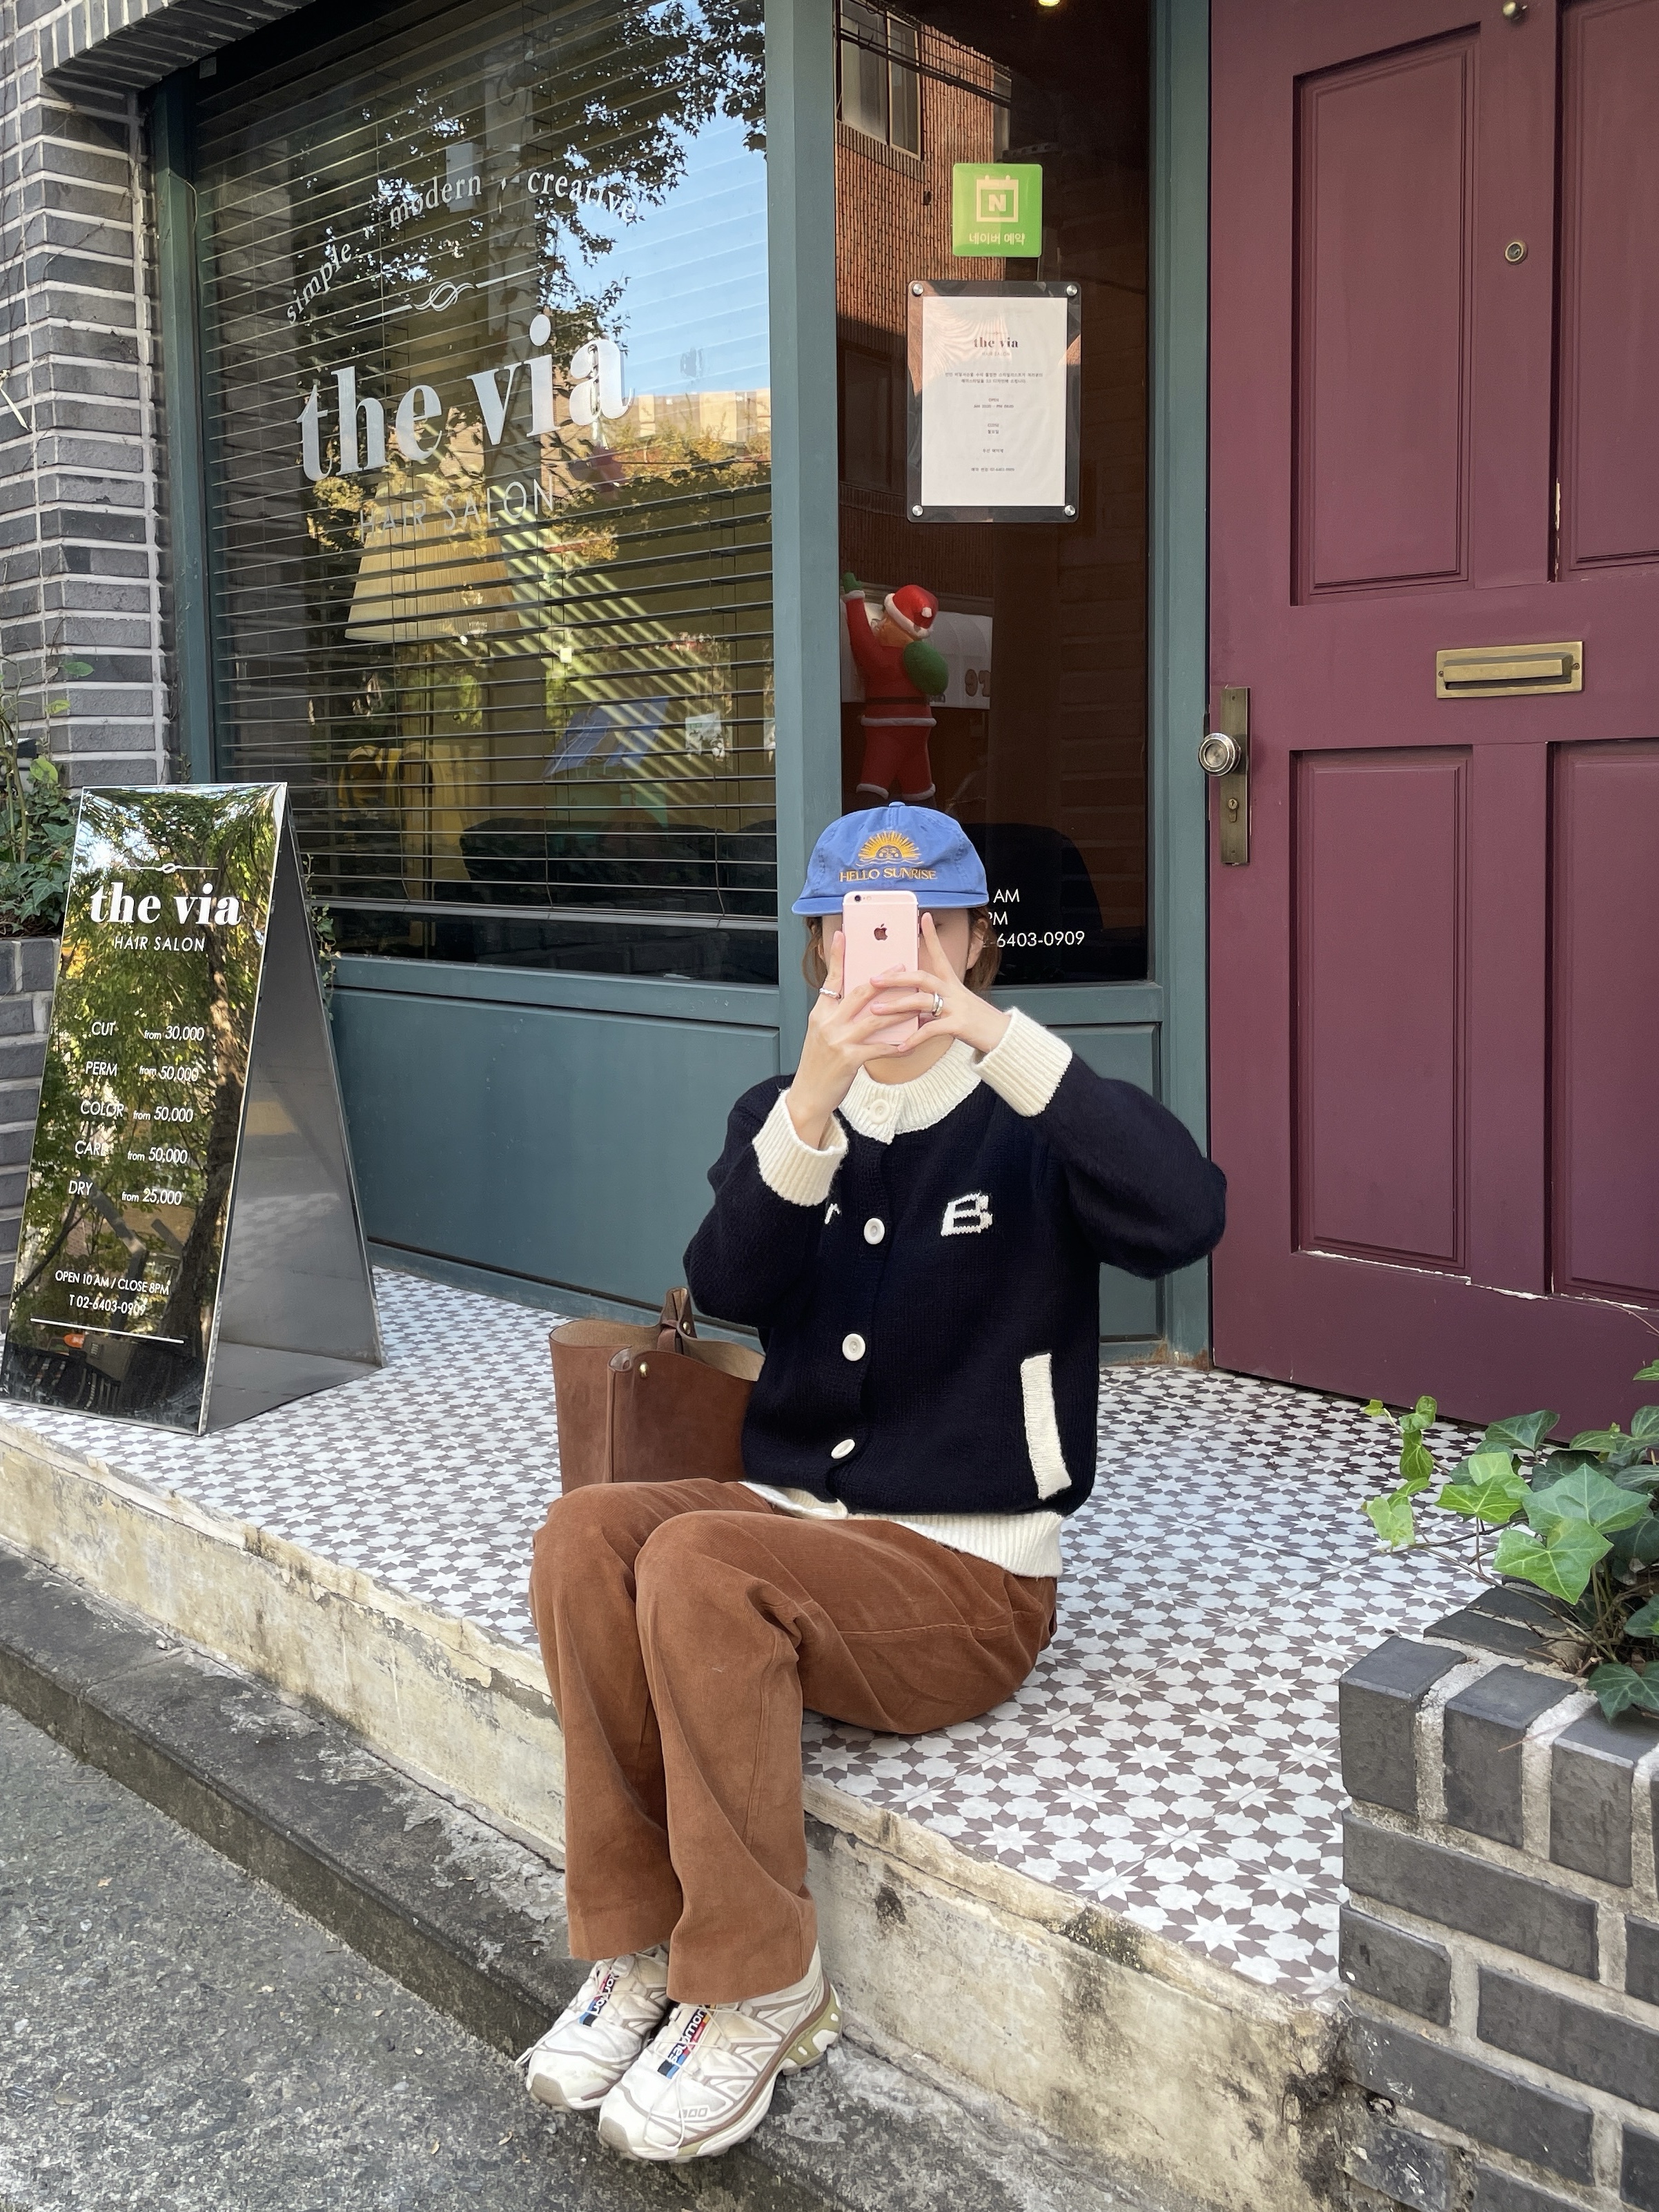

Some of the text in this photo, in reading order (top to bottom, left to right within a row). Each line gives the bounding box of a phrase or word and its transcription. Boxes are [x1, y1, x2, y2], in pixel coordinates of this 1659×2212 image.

[988, 194, 1006, 212] N
[286, 172, 636, 325] simple modern creative
[969, 232, 1025, 246] 네이버 예약
[974, 337, 1019, 348] the via
[296, 314, 636, 482] the via
[360, 473, 554, 543] HAIR SALON
[839, 867, 938, 883] HELLO SUNRISE
[90, 881, 242, 926] the via
[992, 888, 1020, 903] AM
[114, 935, 205, 952] HAIR SALON
[91, 1021, 205, 1041] CUT from 30,000
[85, 1061, 199, 1082] PERM from 50,000
[80, 1099, 194, 1123] COLOR from 50,000
[75, 1140, 188, 1164] CARE from 50,000
[68, 1180, 182, 1206] DRY from 25,000
[940, 1190, 993, 1237] B
[55, 1270, 80, 1284] OPEN
[83, 1273, 92, 1285] 10
[93, 1275, 110, 1288] AM
[117, 1278, 148, 1293] CLOSE
[148, 1283, 170, 1295] 8PM
[69, 1294, 146, 1317] T 02-6403-0909
